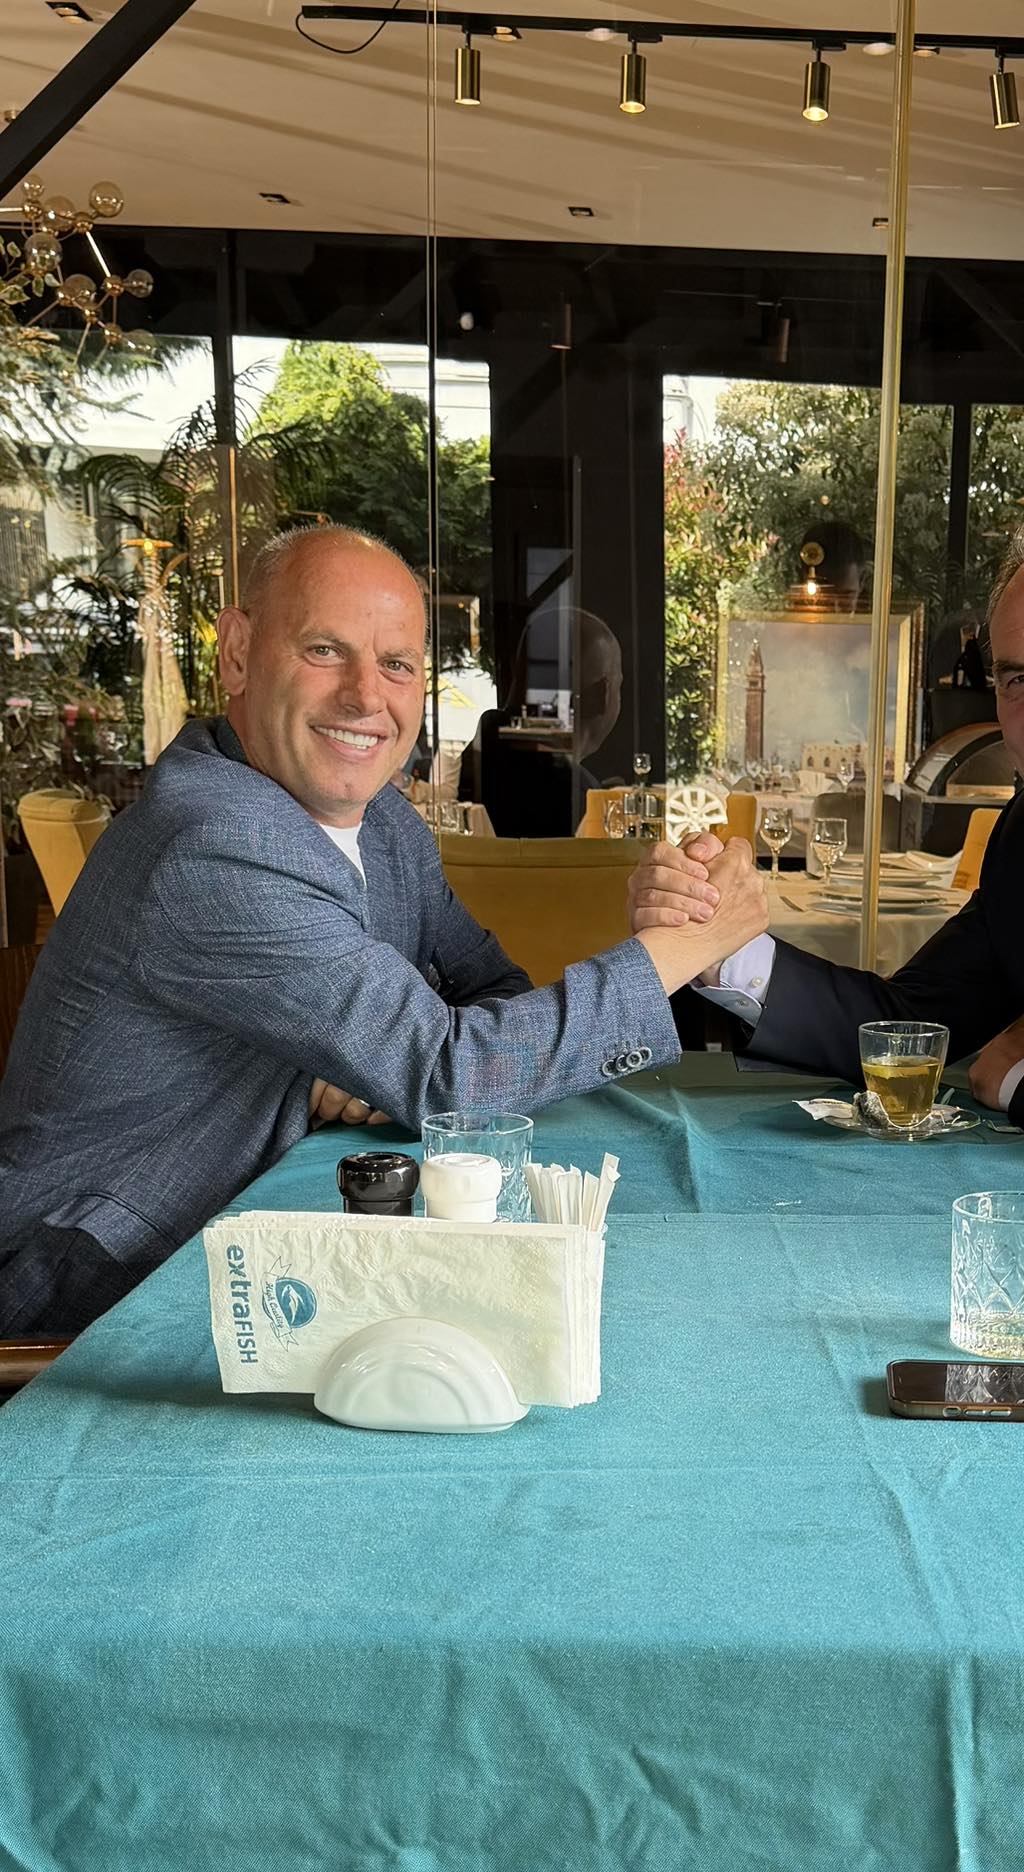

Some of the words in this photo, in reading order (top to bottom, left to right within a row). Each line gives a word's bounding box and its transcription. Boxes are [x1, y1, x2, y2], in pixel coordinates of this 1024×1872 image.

[226, 1245, 258, 1363] extraFISH
[265, 1281, 276, 1302] High
[271, 1302, 285, 1329] Quality
